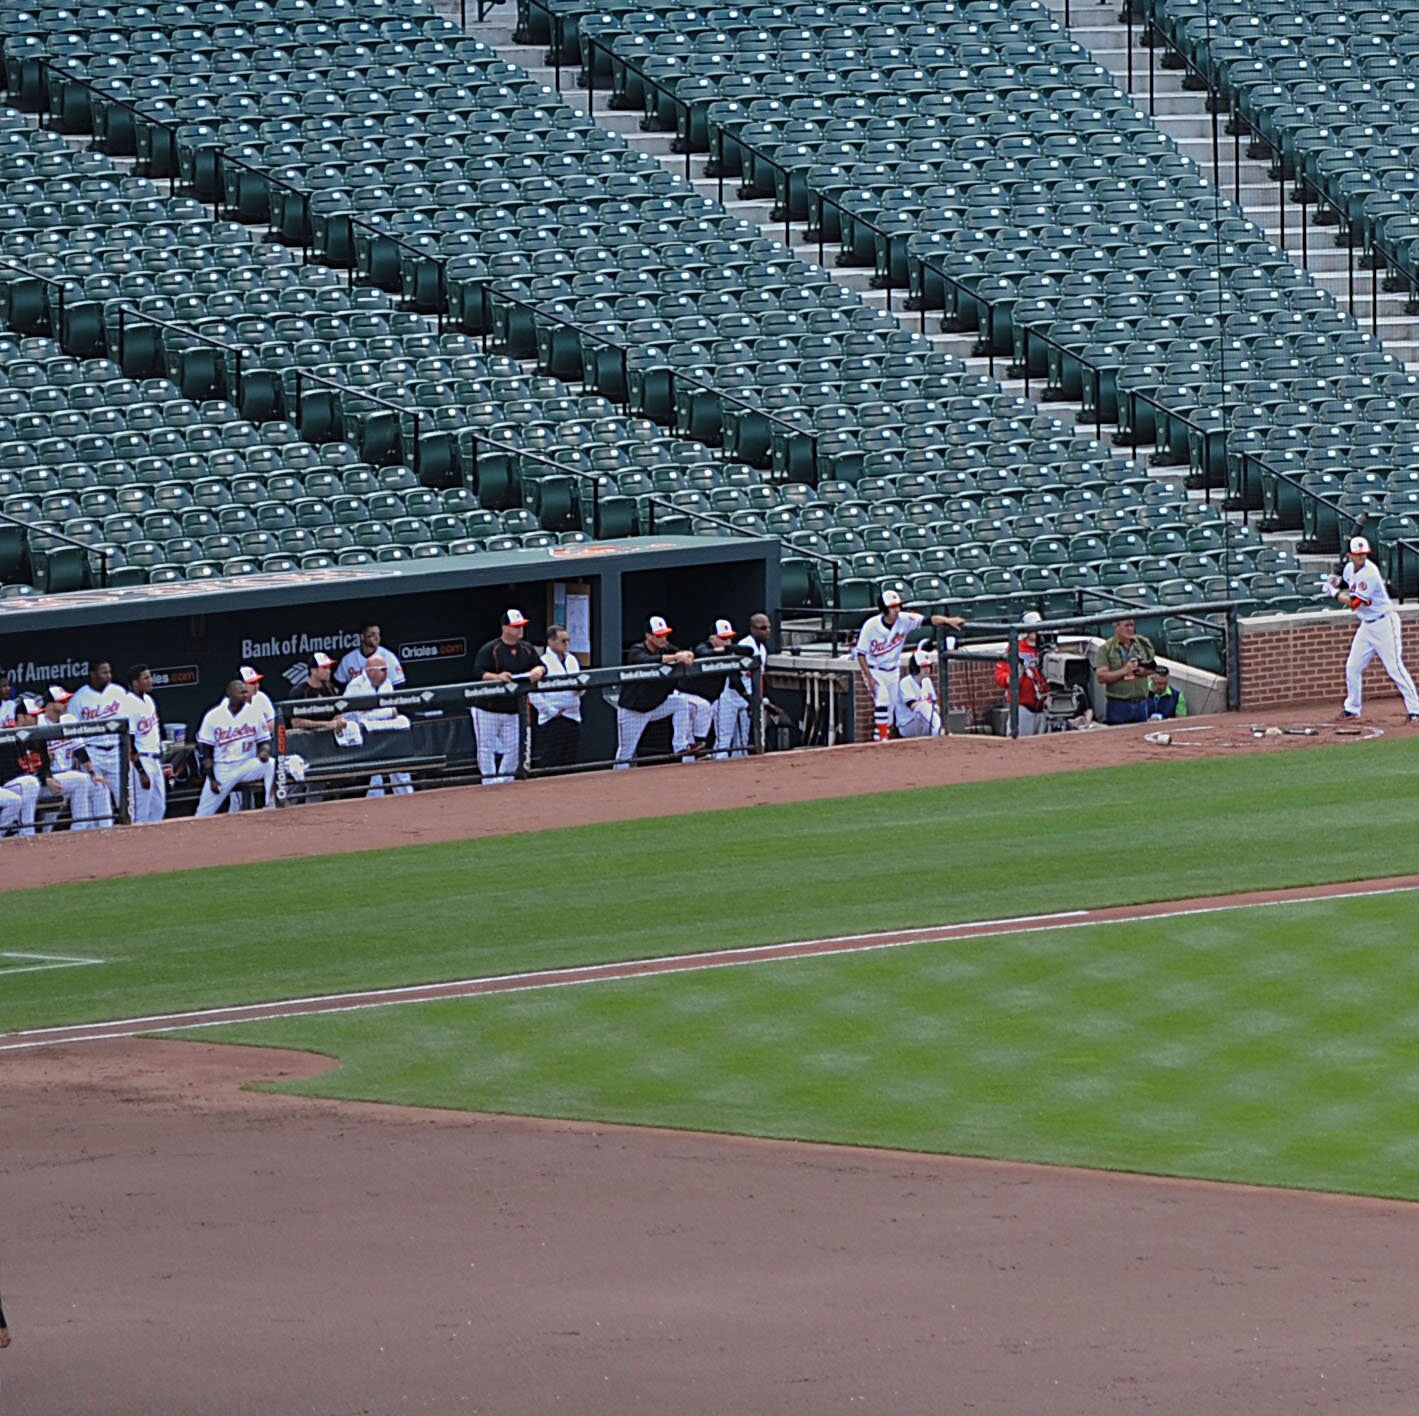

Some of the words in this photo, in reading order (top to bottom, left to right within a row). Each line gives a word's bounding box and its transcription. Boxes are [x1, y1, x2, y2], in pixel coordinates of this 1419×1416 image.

[242, 639, 279, 659] Bank
[282, 634, 298, 654] of
[299, 630, 361, 653] America
[7, 665, 24, 684] of
[25, 658, 89, 682] America
